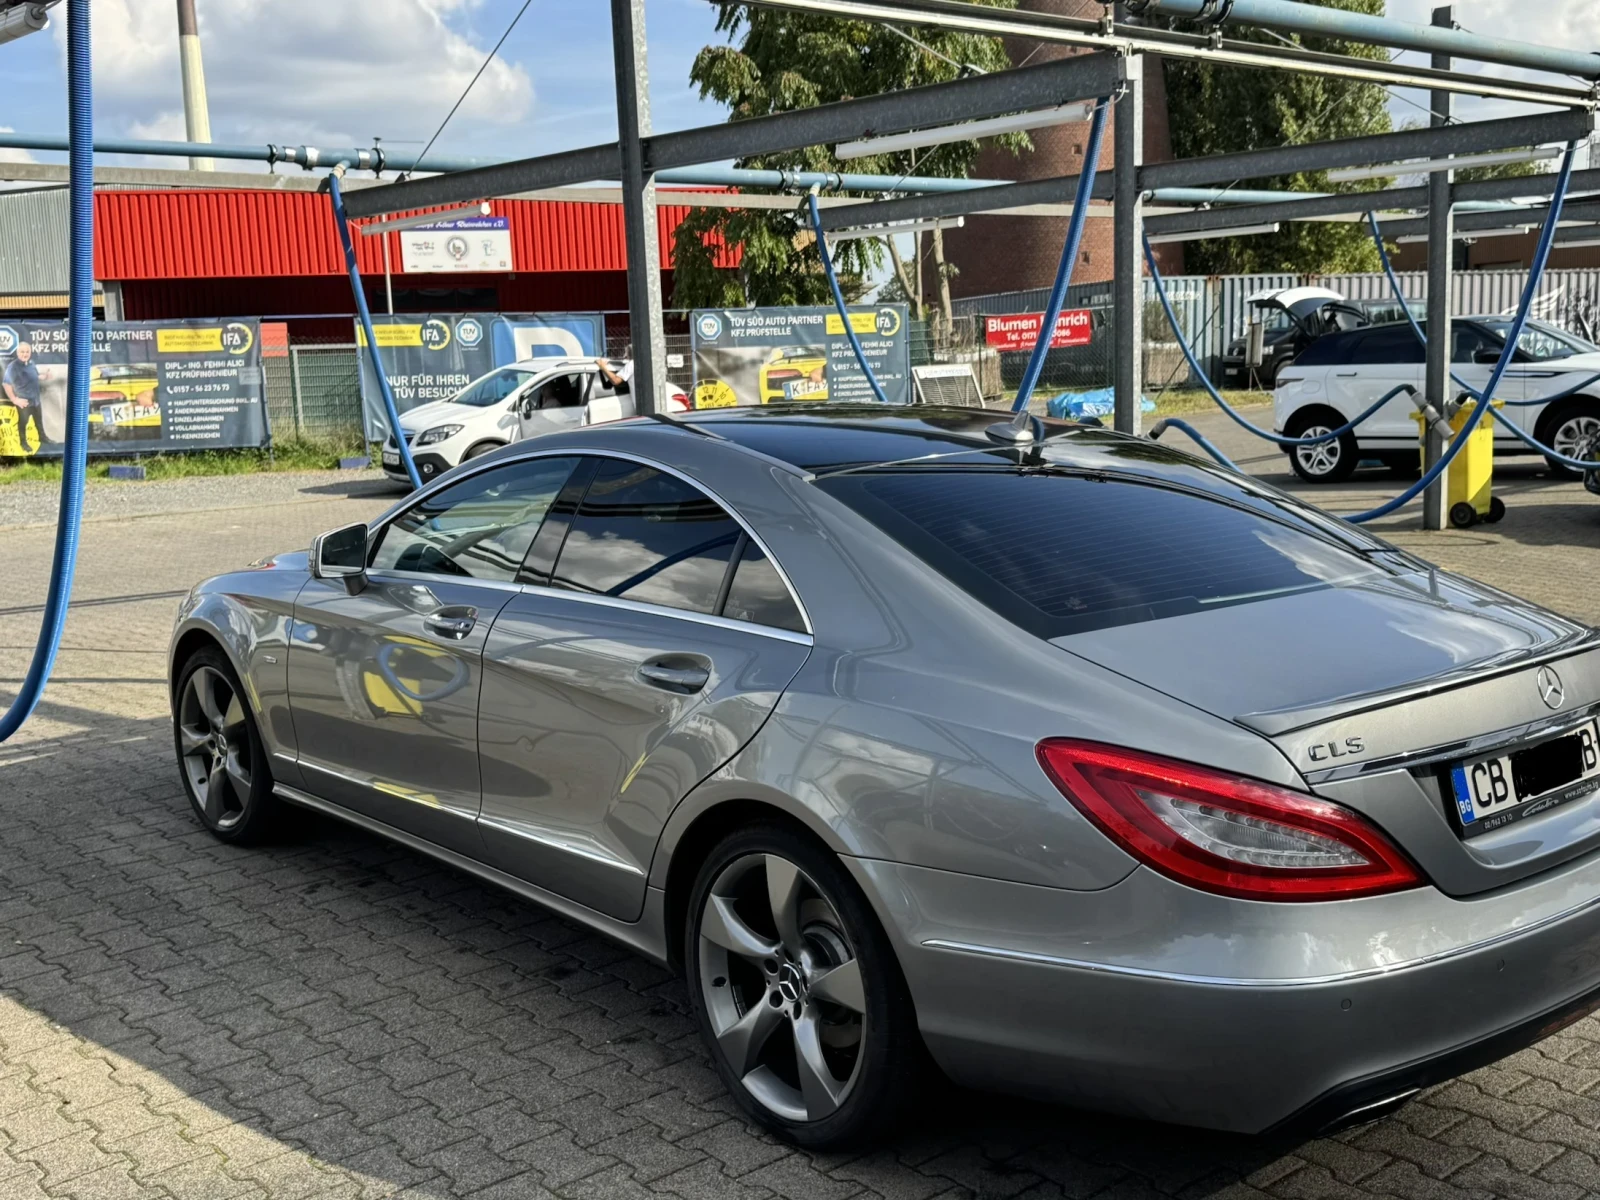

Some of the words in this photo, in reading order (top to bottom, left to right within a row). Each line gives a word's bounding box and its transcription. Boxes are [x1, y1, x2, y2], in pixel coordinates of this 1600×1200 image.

[730, 317, 745, 327] TÜV
[748, 316, 764, 326] SÜD
[765, 316, 786, 326] AUTO
[788, 315, 823, 324] PARTNER
[988, 318, 1036, 332] Blumen
[30, 330, 51, 340] TÜV
[53, 330, 69, 340] SÜ
[106, 330, 153, 341] PARTNER
[731, 329, 745, 337] KFZ
[746, 327, 791, 336] PRÜFSTELLE
[1006, 333, 1020, 341] Tel.
[32, 343, 50, 352] KFZ
[166, 371, 180, 379] KFZ
[181, 369, 237, 378] PRÜFINGENIEUR
[386, 375, 409, 386] NUR
[412, 374, 434, 386] FÜR
[437, 374, 469, 385] IHREN
[394, 387, 415, 398] TÜV
[1308, 737, 1365, 762] CLS
[1472, 758, 1508, 808] CB
[1460, 800, 1472, 814] BG
